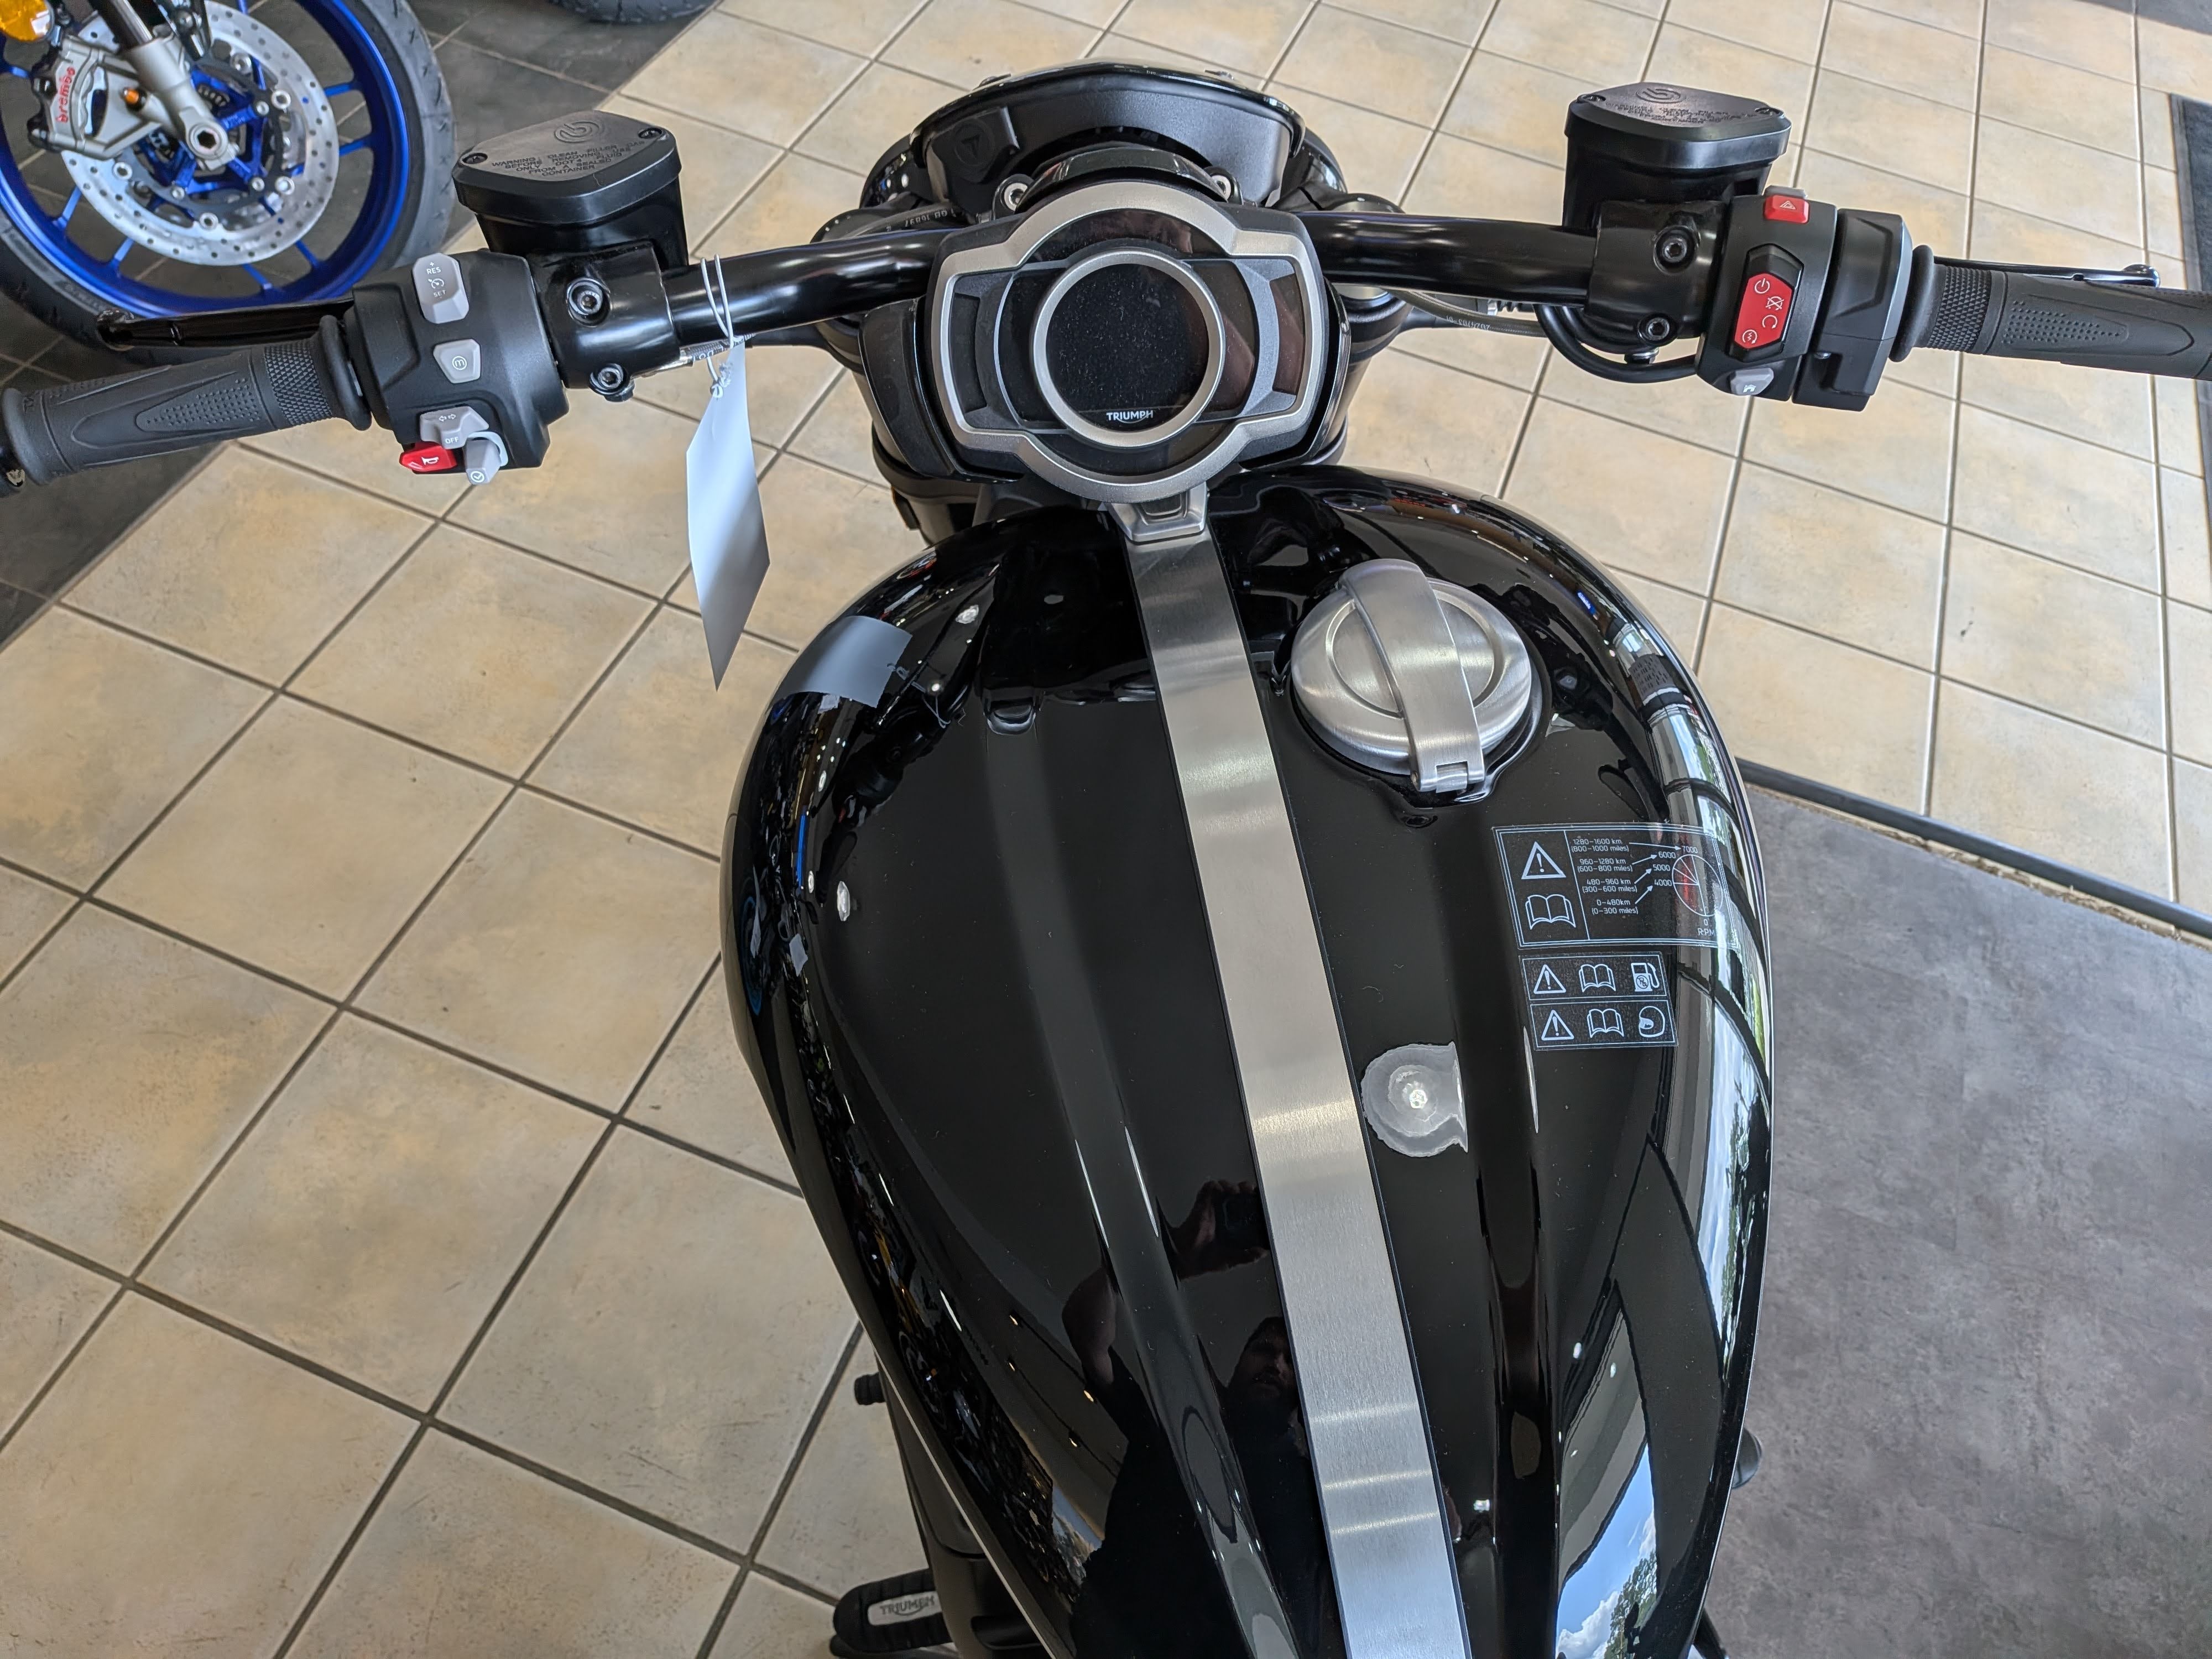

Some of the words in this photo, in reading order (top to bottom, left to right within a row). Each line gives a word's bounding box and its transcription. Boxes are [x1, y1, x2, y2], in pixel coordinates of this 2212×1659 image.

[433, 289, 446, 298] SET
[1107, 410, 1154, 424] TRIUMPH
[1681, 845, 1698, 854] 7000
[1619, 906, 1639, 915] miles)
[880, 1595, 936, 1616] TRIUMPH
